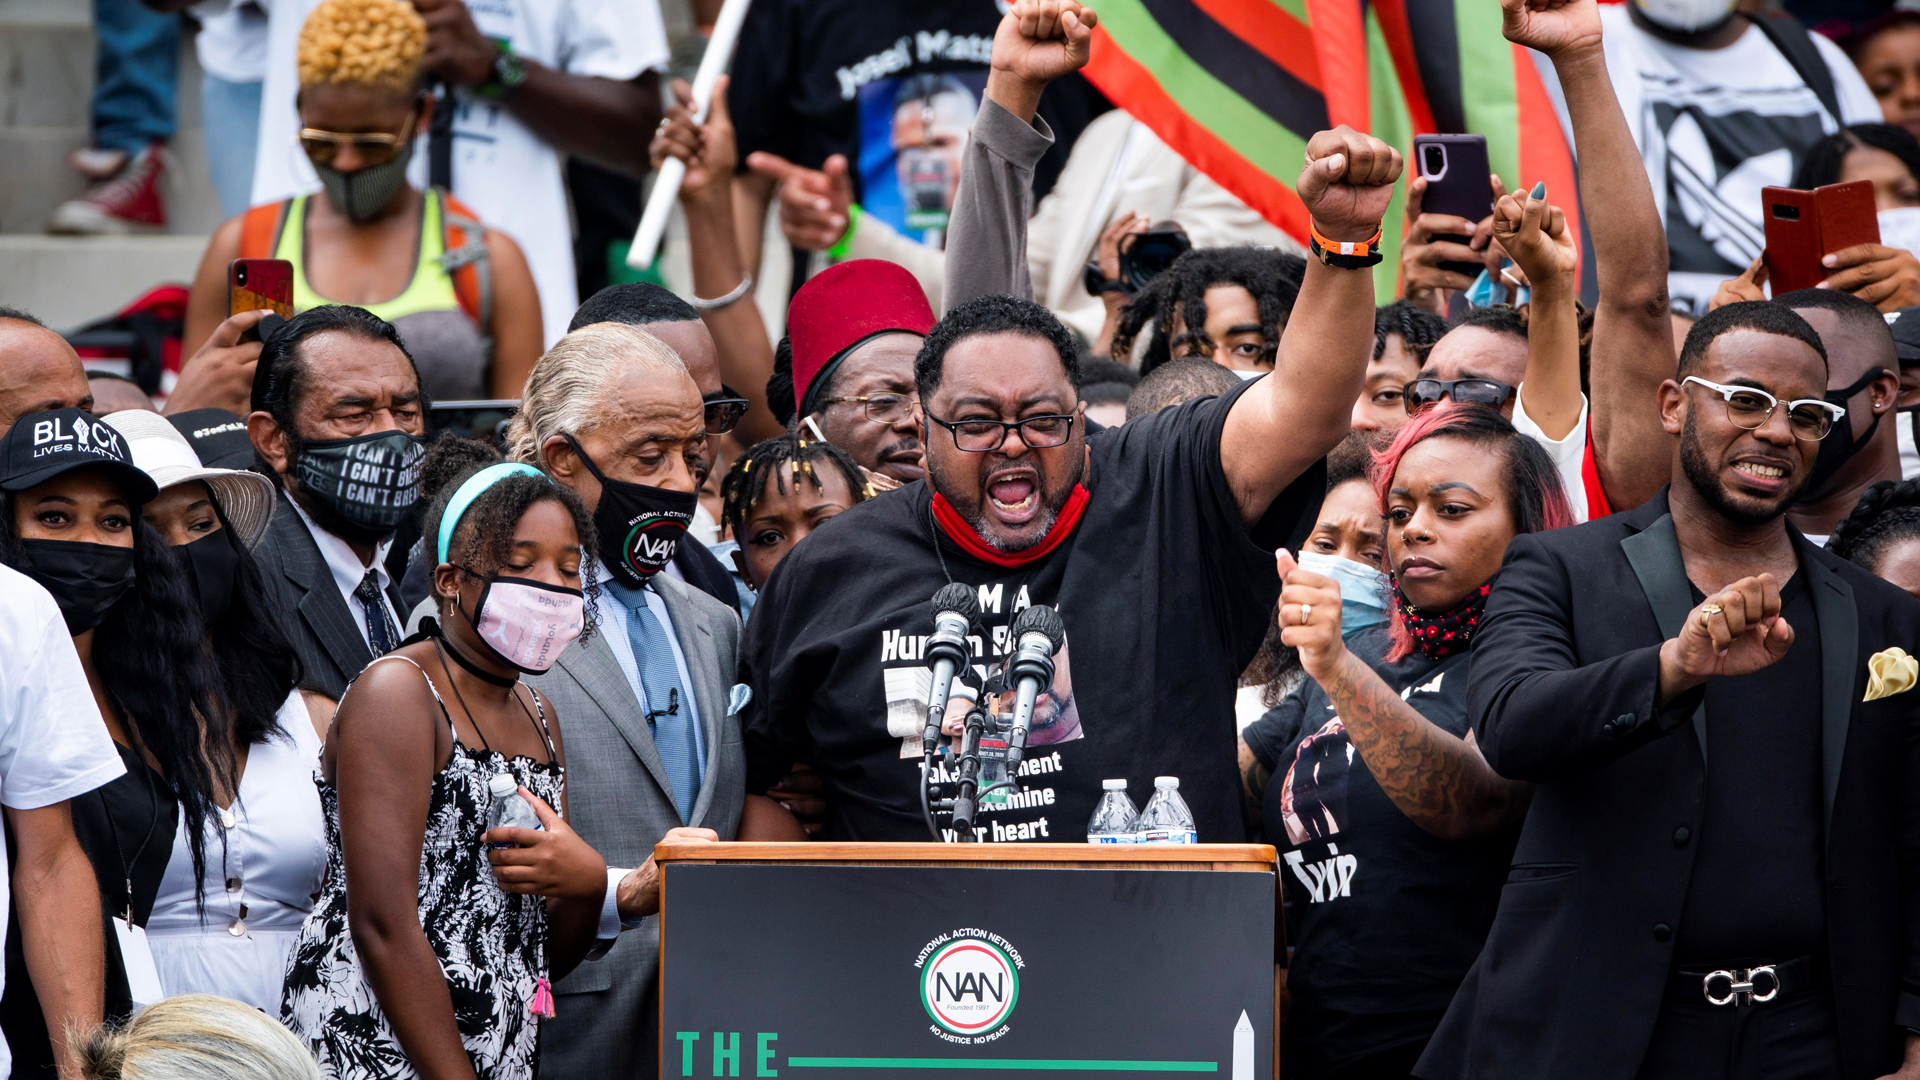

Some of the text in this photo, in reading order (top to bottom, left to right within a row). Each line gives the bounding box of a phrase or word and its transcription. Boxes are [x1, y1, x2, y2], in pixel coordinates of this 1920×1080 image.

[34, 418, 123, 459] BLCK
[34, 444, 120, 461] LIVES MATT
[341, 460, 348, 477] I
[350, 462, 395, 486] CAN'T
[336, 480, 343, 497] I
[346, 483, 391, 507] CAN'T
[628, 511, 661, 526] NATIONAL
[522, 618, 544, 664] yolanda
[881, 629, 983, 662] Hun
[942, 816, 1049, 843] yr heart
[1283, 843, 1358, 903] Twin
[914, 928, 1025, 970] NATIONAL ACTION NETWORK
[936, 972, 1003, 1002] NAN
[929, 1025, 941, 1036] NO
[940, 1033, 971, 1044] JUSTICE
[986, 1024, 1010, 1042] PEACE
[676, 1032, 778, 1077] THE
